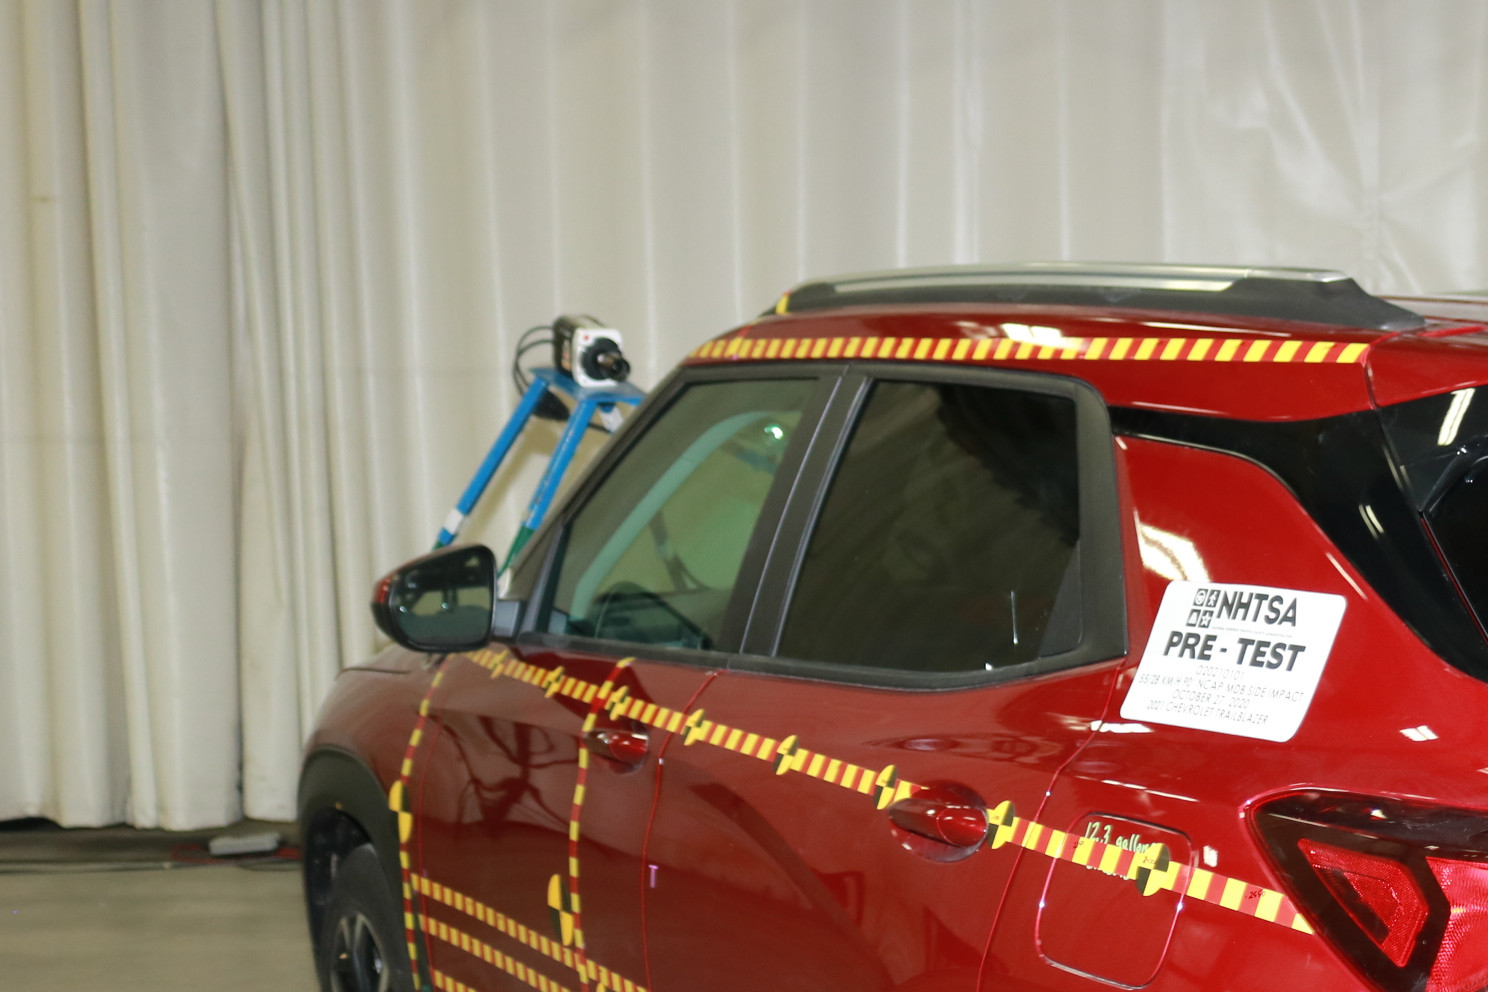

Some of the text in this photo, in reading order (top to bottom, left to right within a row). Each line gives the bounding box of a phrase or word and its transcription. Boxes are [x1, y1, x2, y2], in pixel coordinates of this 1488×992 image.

[1216, 590, 1297, 627] NHTSA
[1162, 630, 1218, 661] PRE
[1236, 637, 1307, 672] TEST
[1172, 689, 1212, 703] OCTOBER
[1228, 697, 1250, 709] 2020
[1198, 679, 1224, 691] NCAP
[1226, 683, 1246, 695] MDB
[1247, 685, 1267, 698] SIDE
[1268, 689, 1304, 703] IMPACT
[1146, 699, 1269, 725] 2021 CHEVROLET TRAILBLAZER
